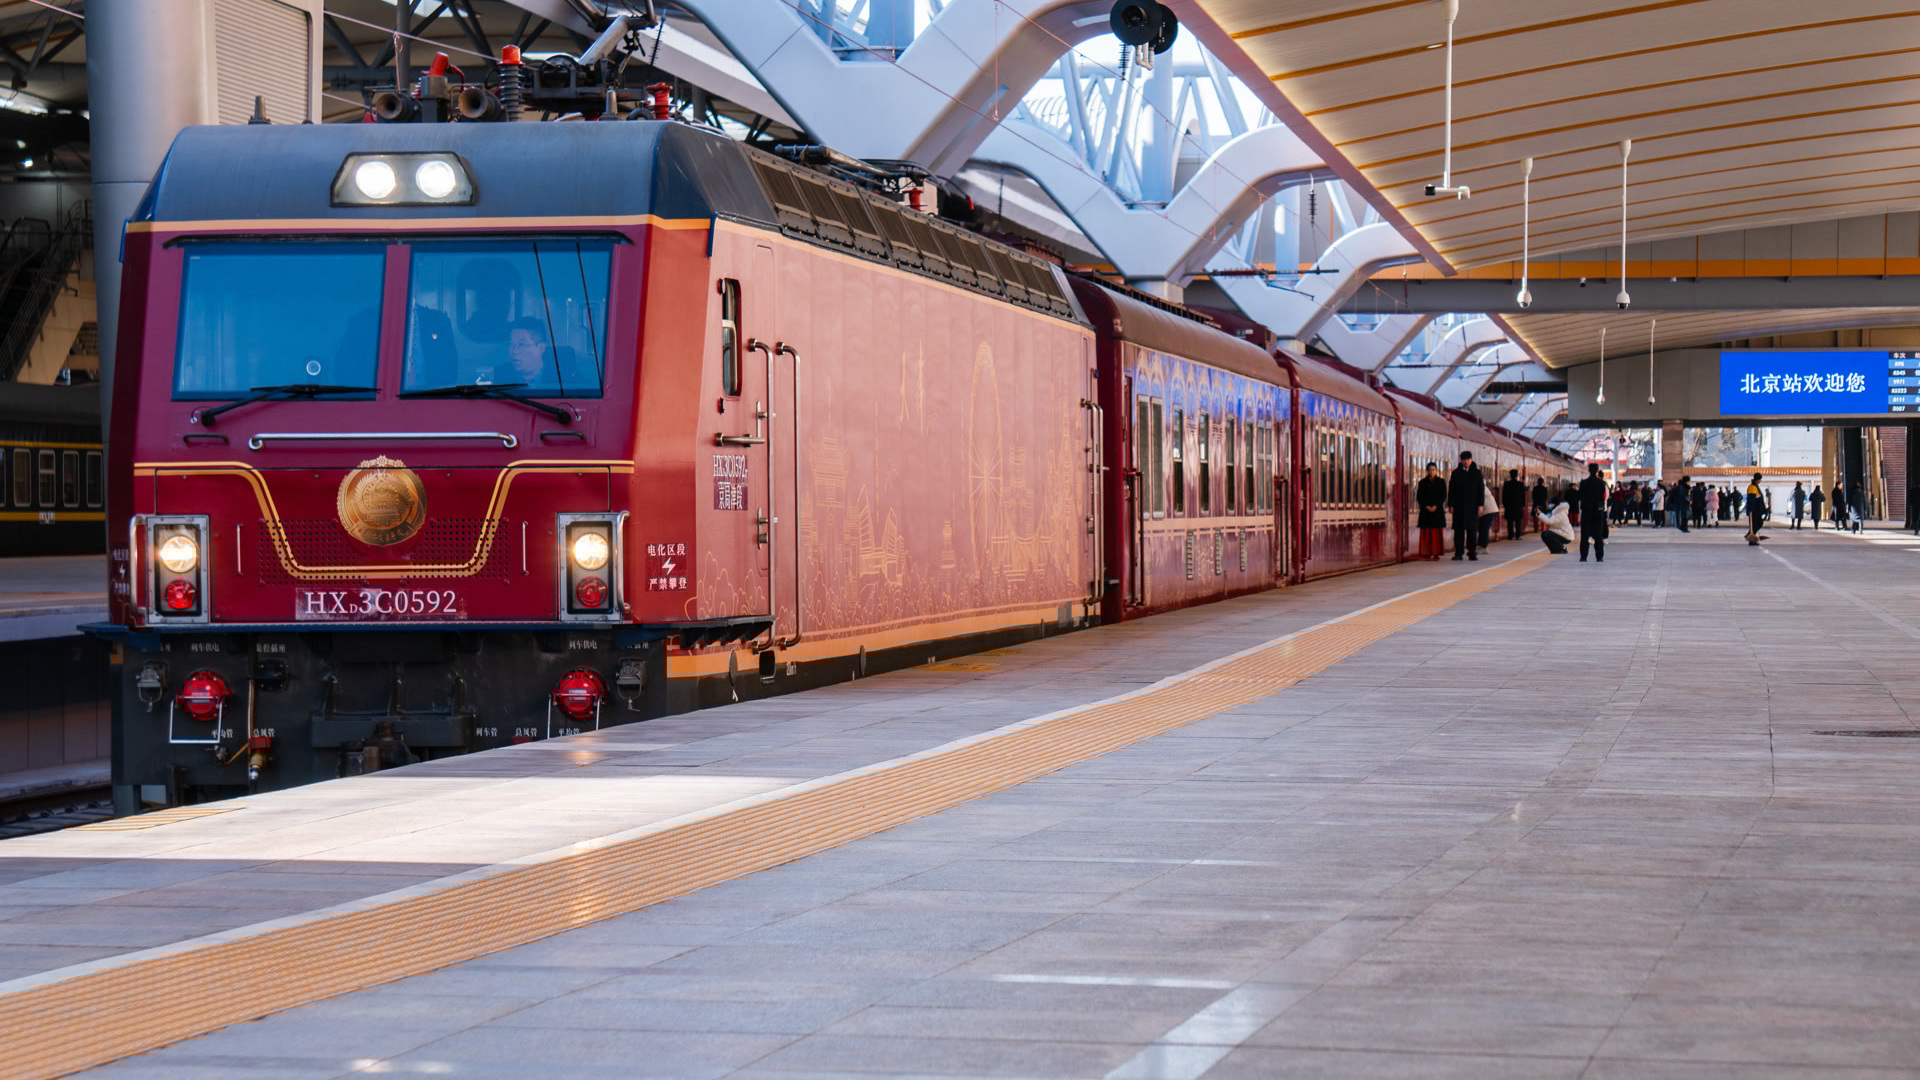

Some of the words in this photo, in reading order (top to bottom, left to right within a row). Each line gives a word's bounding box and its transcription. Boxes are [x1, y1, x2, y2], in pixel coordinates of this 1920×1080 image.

[1740, 373, 1866, 394] 北京站欢迎您
[647, 543, 686, 556] 电化区段
[649, 577, 688, 590] 严禁攀登
[304, 590, 457, 614] HXD3C0592
[568, 639, 598, 650] 列车供电
[475, 727, 498, 737] 列车管
[515, 727, 538, 737] 总风管
